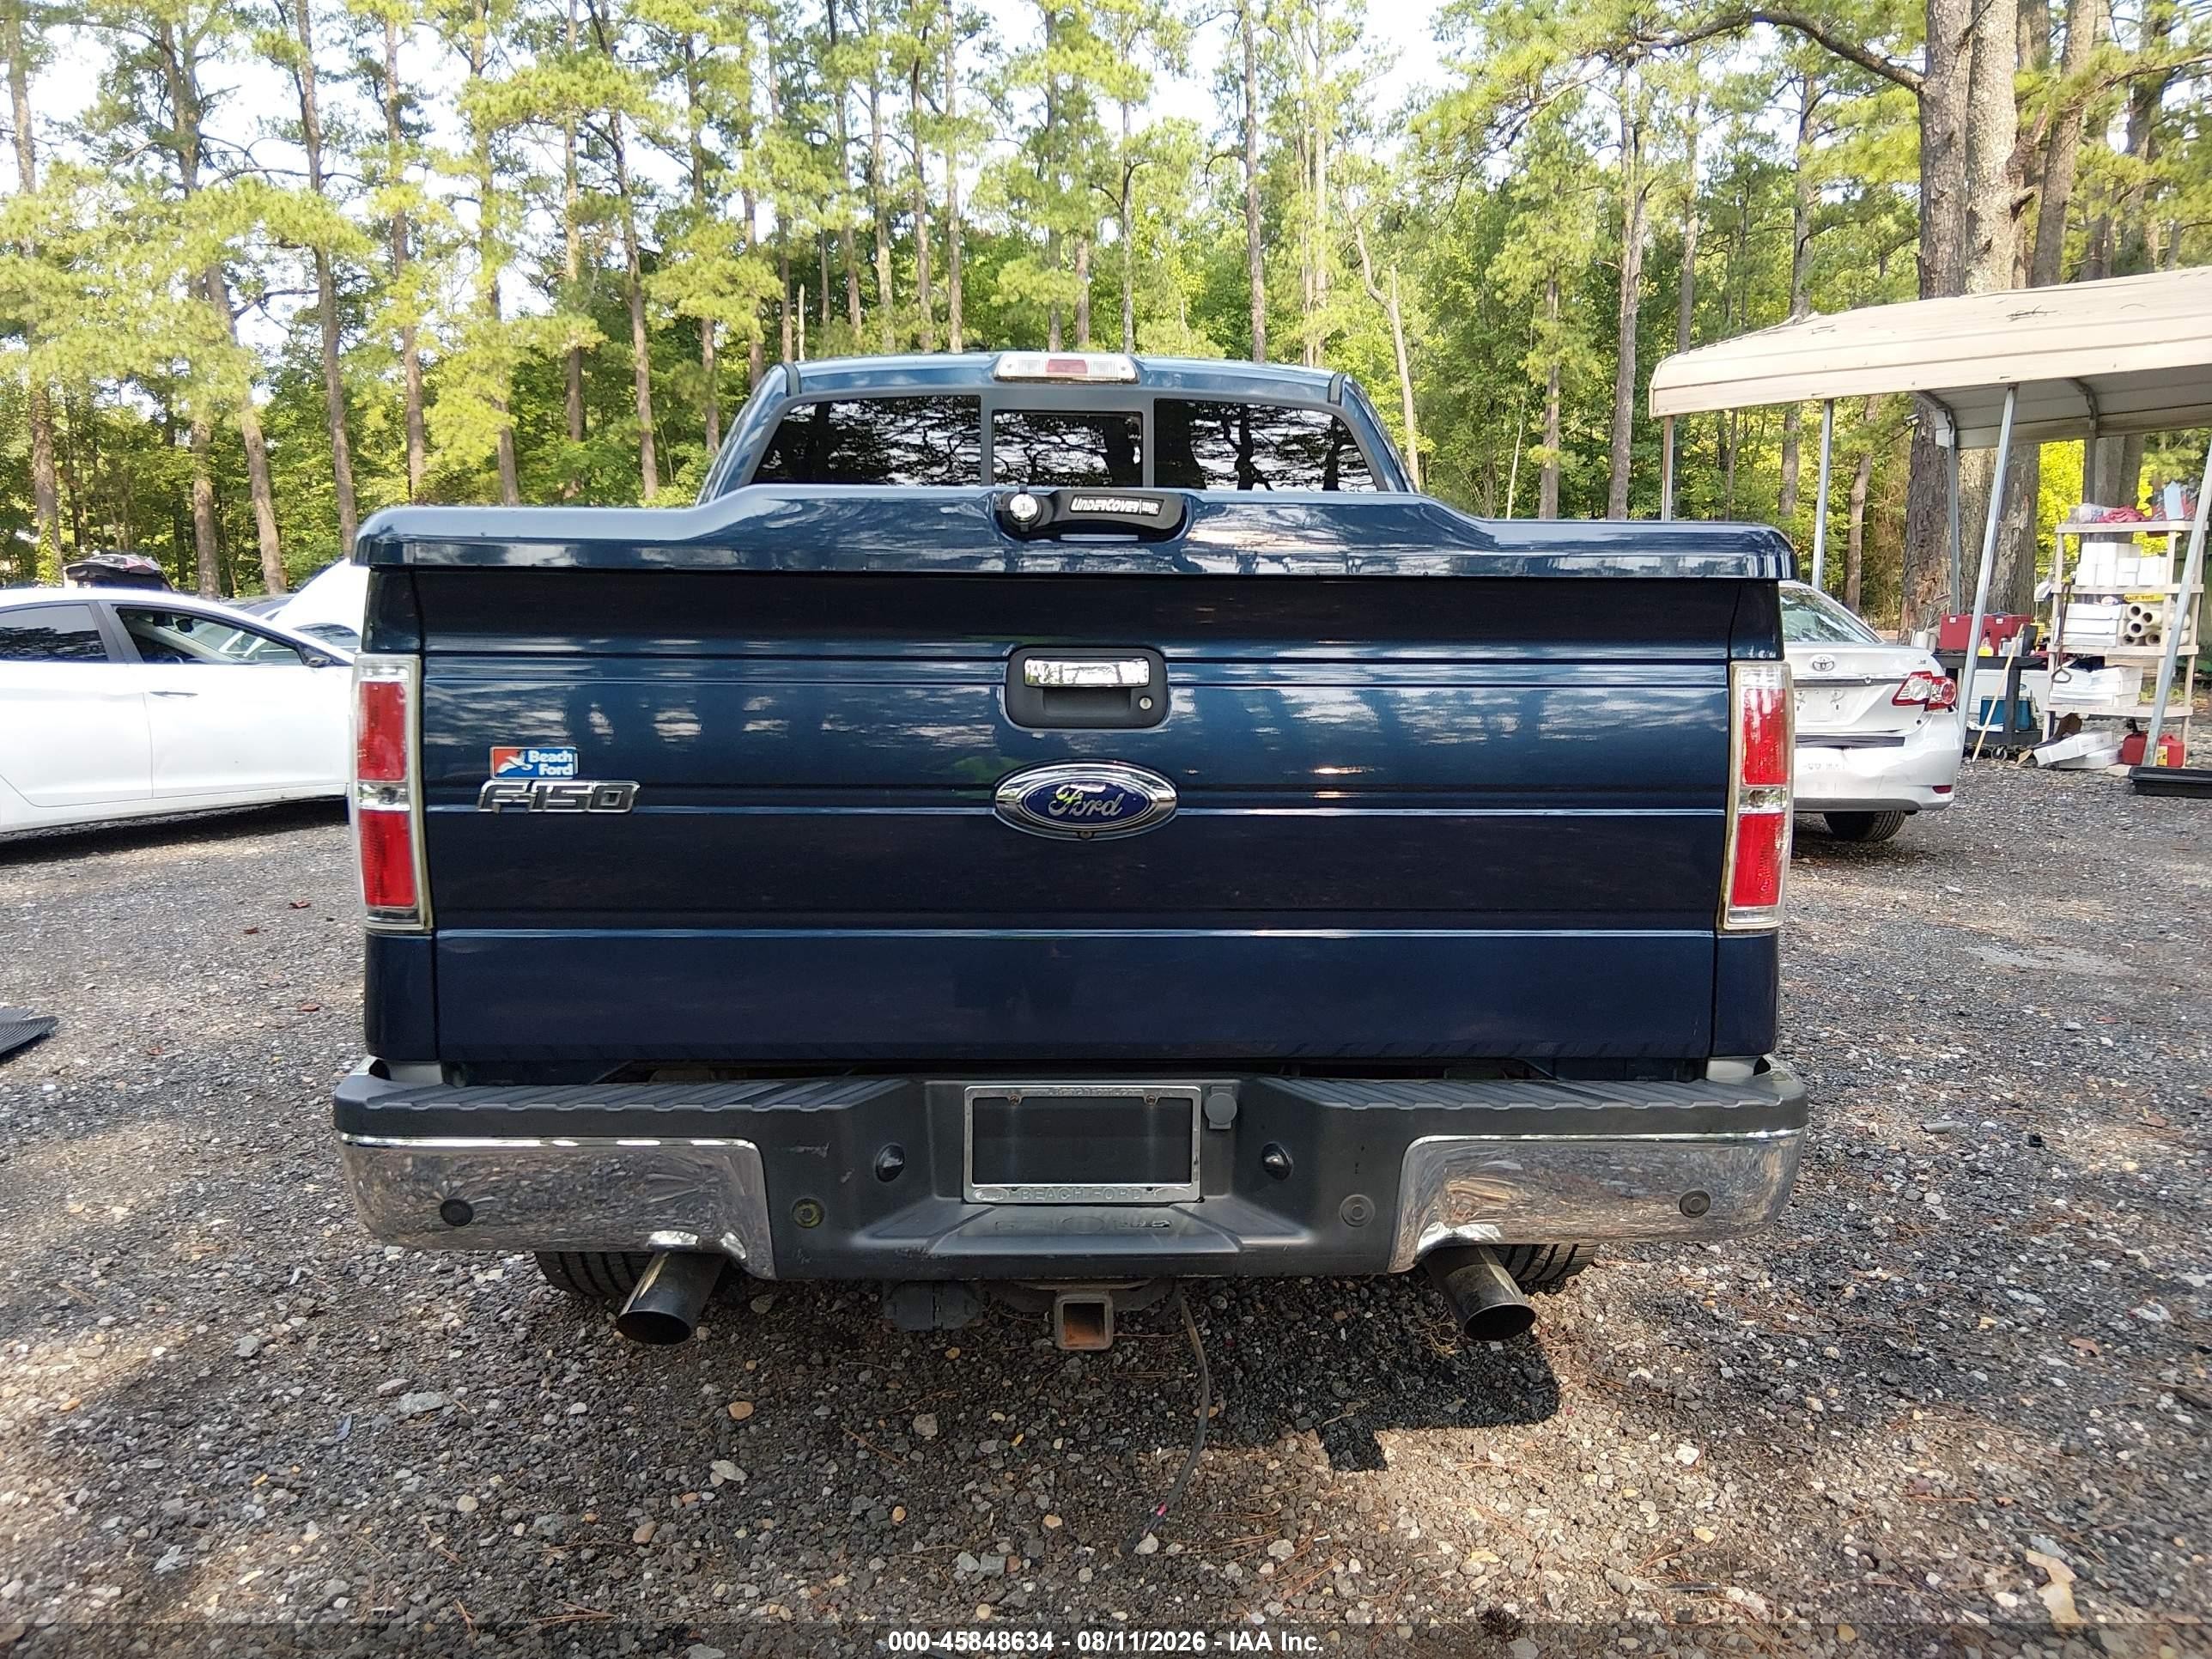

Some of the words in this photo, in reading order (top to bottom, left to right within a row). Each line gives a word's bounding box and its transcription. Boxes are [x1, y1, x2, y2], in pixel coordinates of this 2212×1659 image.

[527, 750, 574, 763] Beach
[538, 763, 574, 776] Ford
[477, 780, 641, 815] F-150
[1048, 783, 1124, 817] Ford
[1019, 1187, 1085, 1200] BEACH
